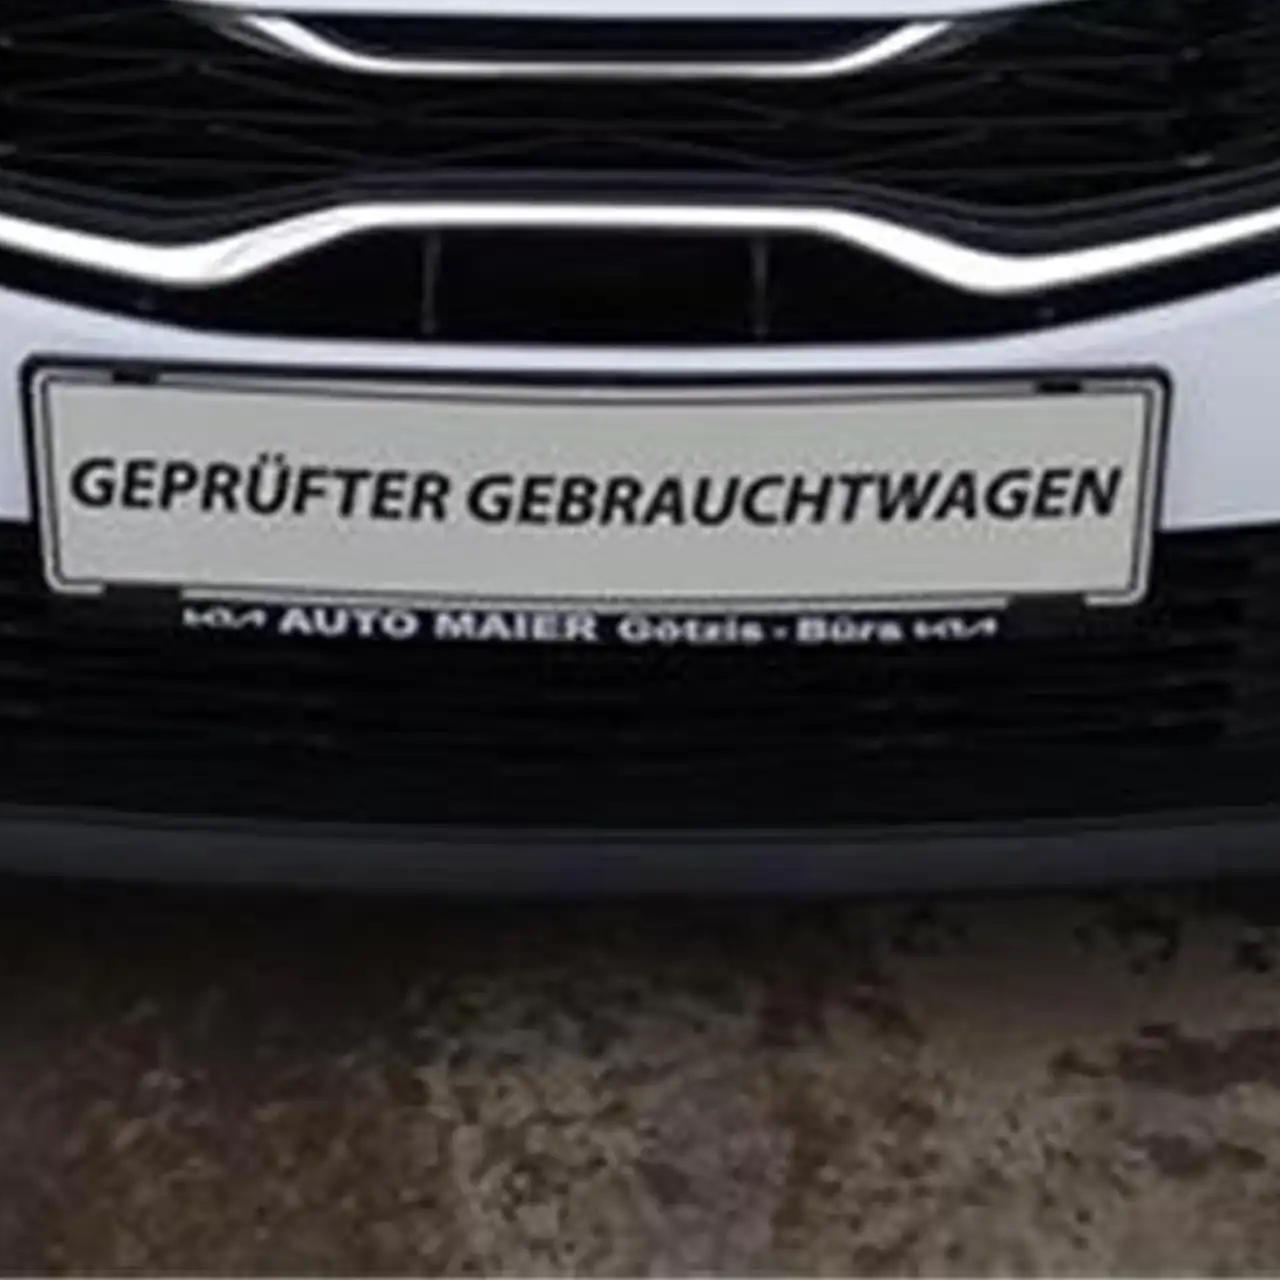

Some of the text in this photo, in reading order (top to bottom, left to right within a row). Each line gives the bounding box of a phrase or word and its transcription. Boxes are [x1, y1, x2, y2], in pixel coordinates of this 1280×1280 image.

[69, 452, 1122, 526] GEPRÜFTER GEBRAUCHTWAGEN
[278, 606, 419, 639] AUTO
[434, 611, 599, 642] MAIER
